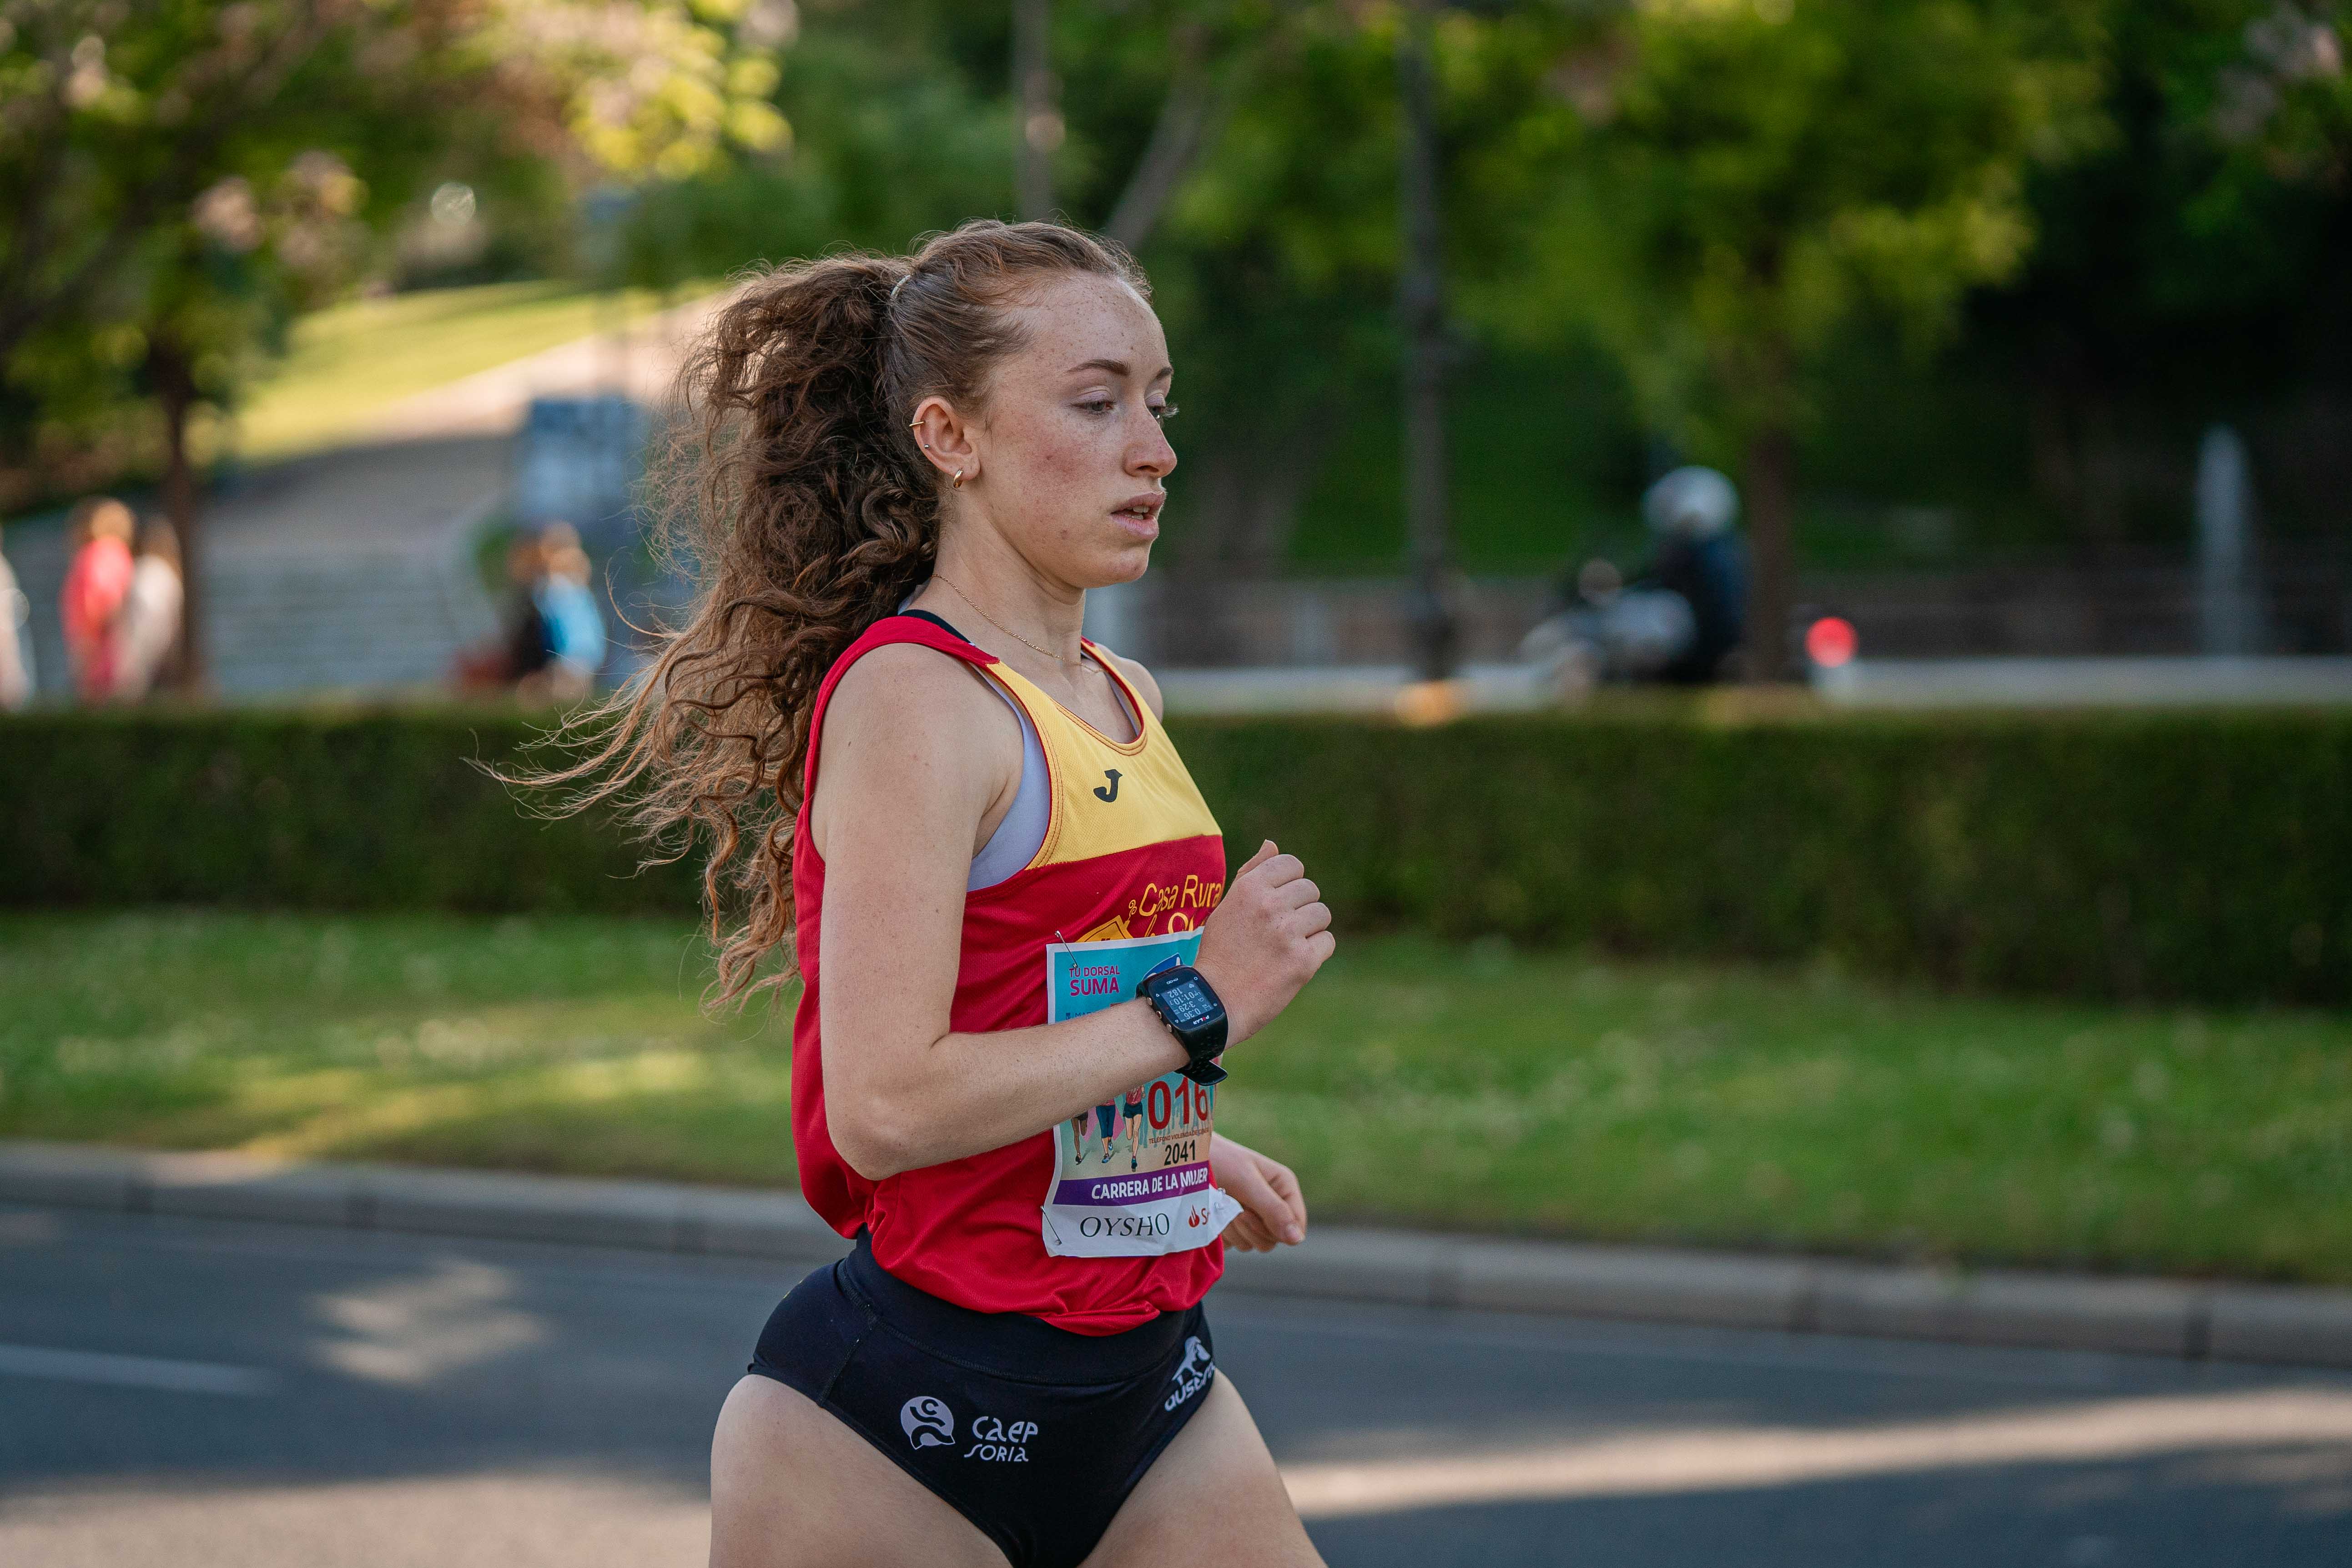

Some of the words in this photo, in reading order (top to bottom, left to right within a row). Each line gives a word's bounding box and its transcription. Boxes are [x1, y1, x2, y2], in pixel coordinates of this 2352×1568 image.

[1139, 883, 1179, 917] Casa
[1069, 967, 1081, 978] TU
[1083, 965, 1120, 977] DORSAL
[1070, 977, 1120, 996] SUMA
[1167, 988, 1183, 998] 182
[1179, 1001, 1195, 1012] 3:29
[1184, 1008, 1201, 1019] 0.36
[1193, 1015, 1209, 1024] POLAR
[1148, 1077, 1208, 1130] 016
[1163, 1139, 1196, 1166] 2041
[1092, 1179, 1149, 1199] CARRERA
[1152, 1176, 1163, 1193] DE
[1165, 1173, 1179, 1190] LA
[1180, 1167, 1209, 1187] MUJER
[1079, 1212, 1170, 1238] OYSHO
